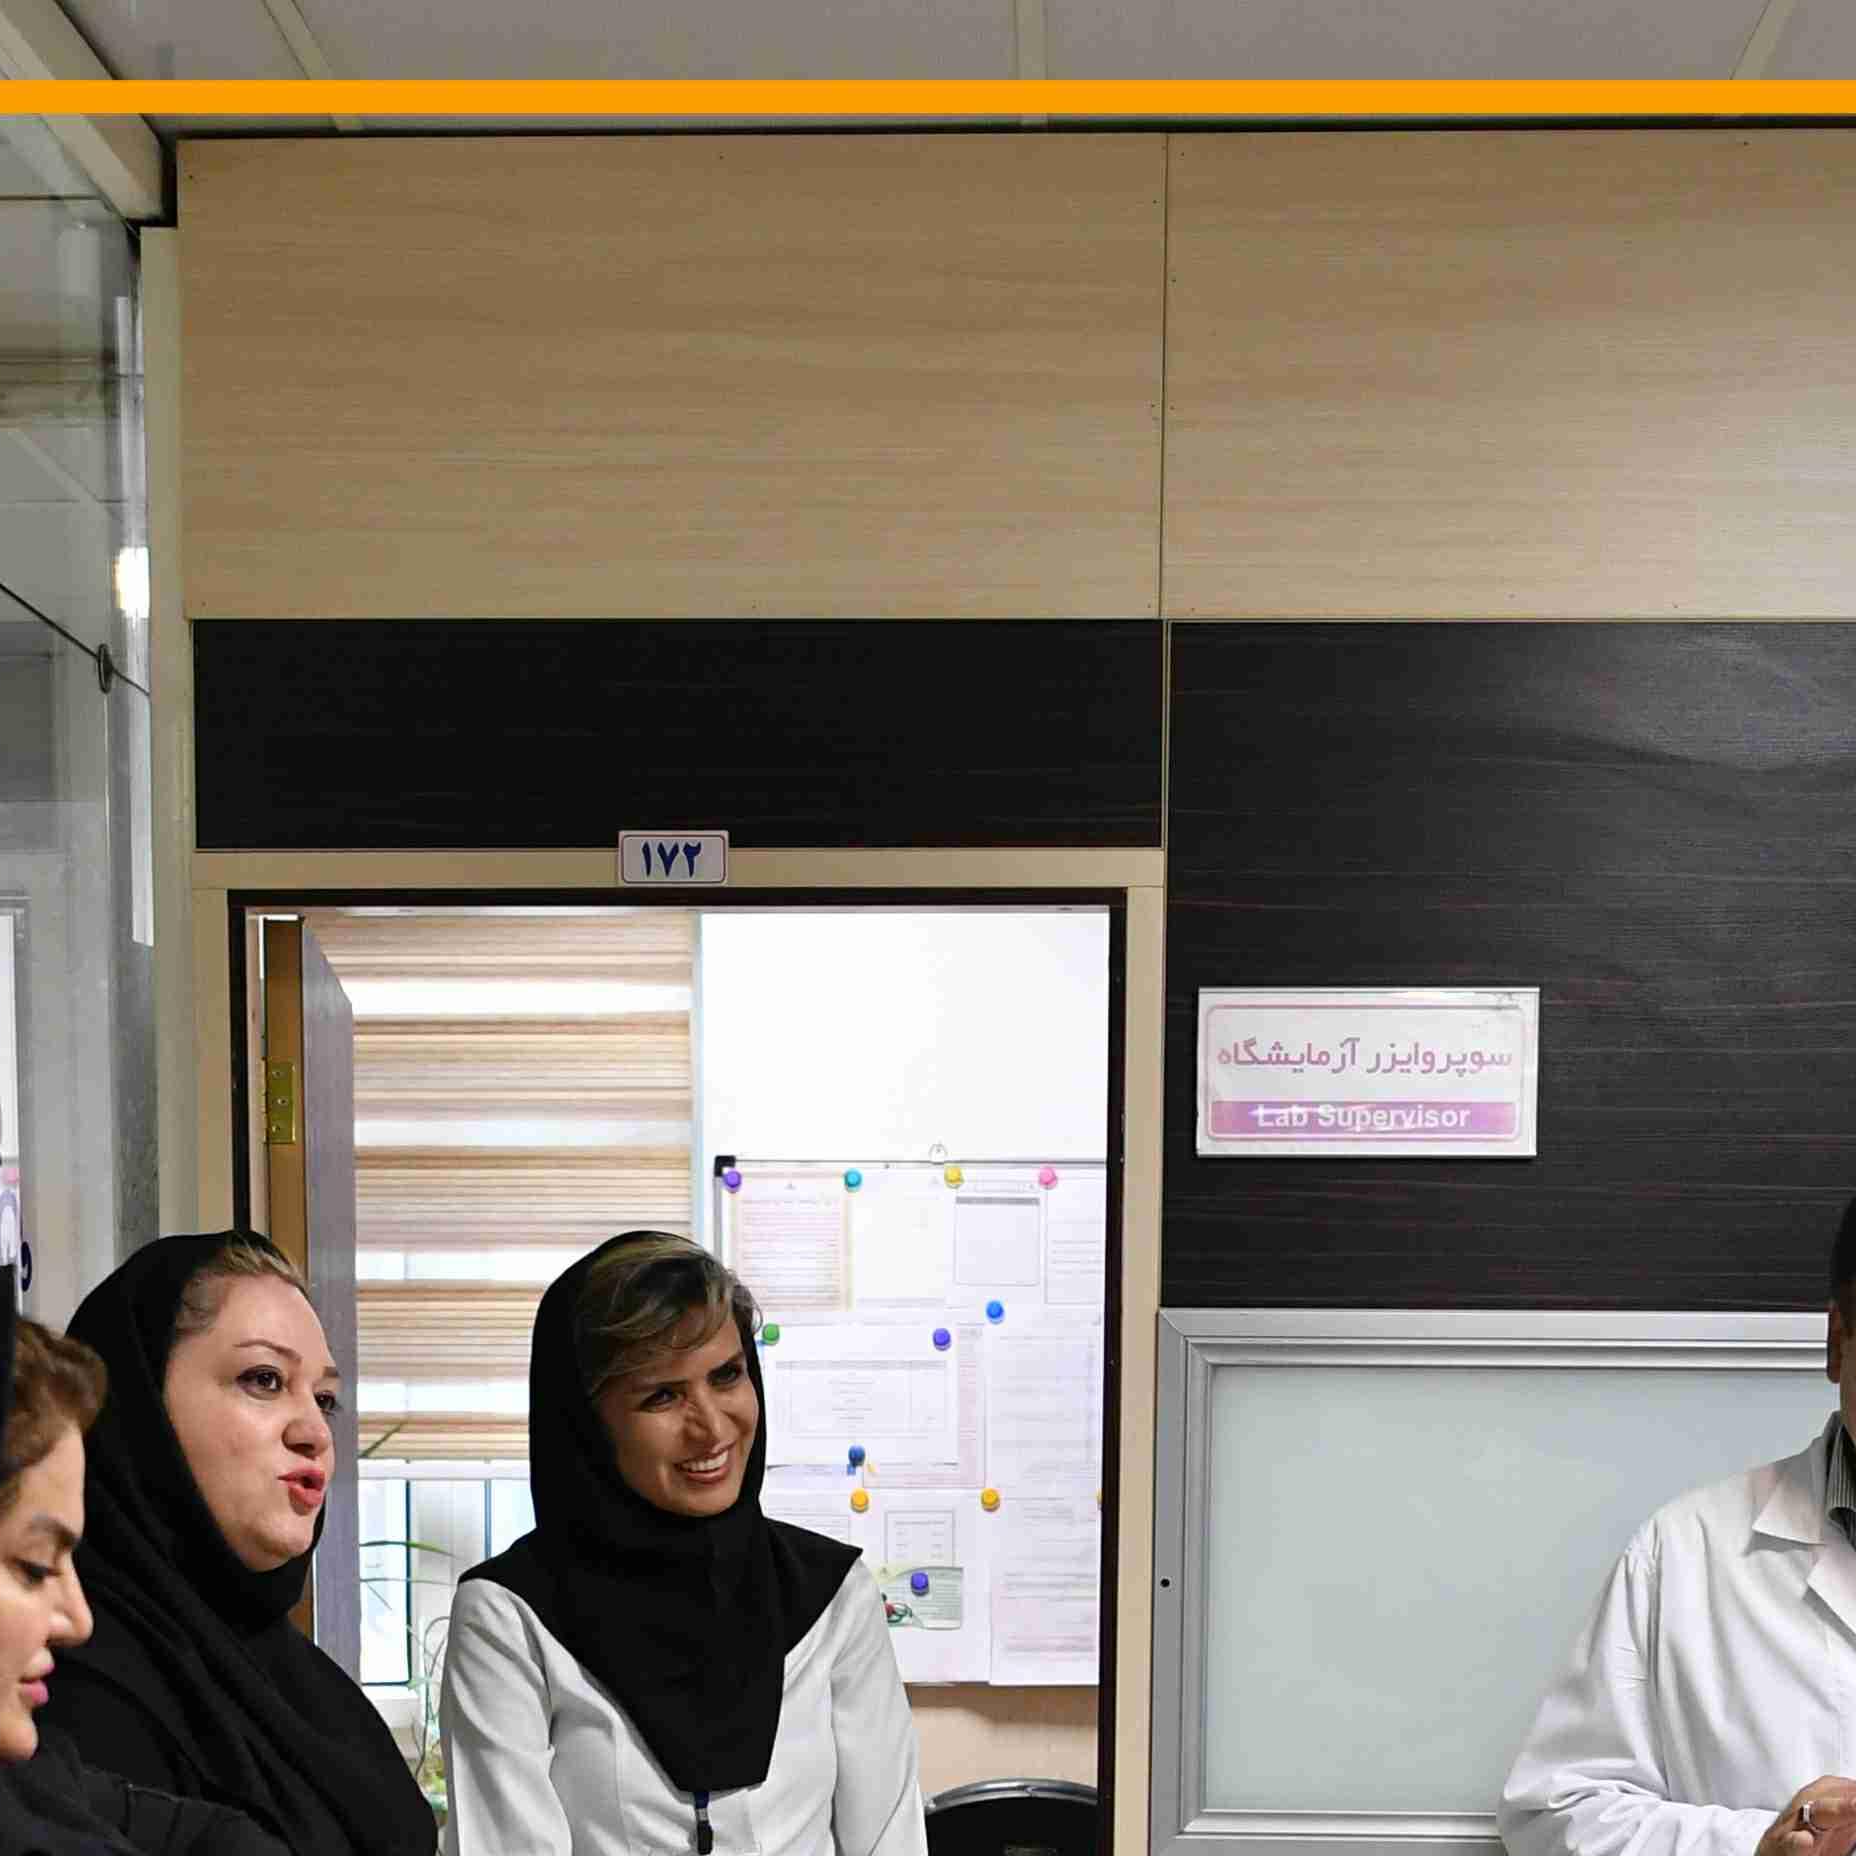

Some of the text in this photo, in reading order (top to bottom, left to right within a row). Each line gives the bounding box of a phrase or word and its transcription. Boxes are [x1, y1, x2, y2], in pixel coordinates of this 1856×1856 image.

[641, 841, 702, 878] ۱۷۲
[1217, 1037, 1512, 1077] سوپروایزر آزمایشگاه
[1256, 1104, 1471, 1133] Lab Supervisor
